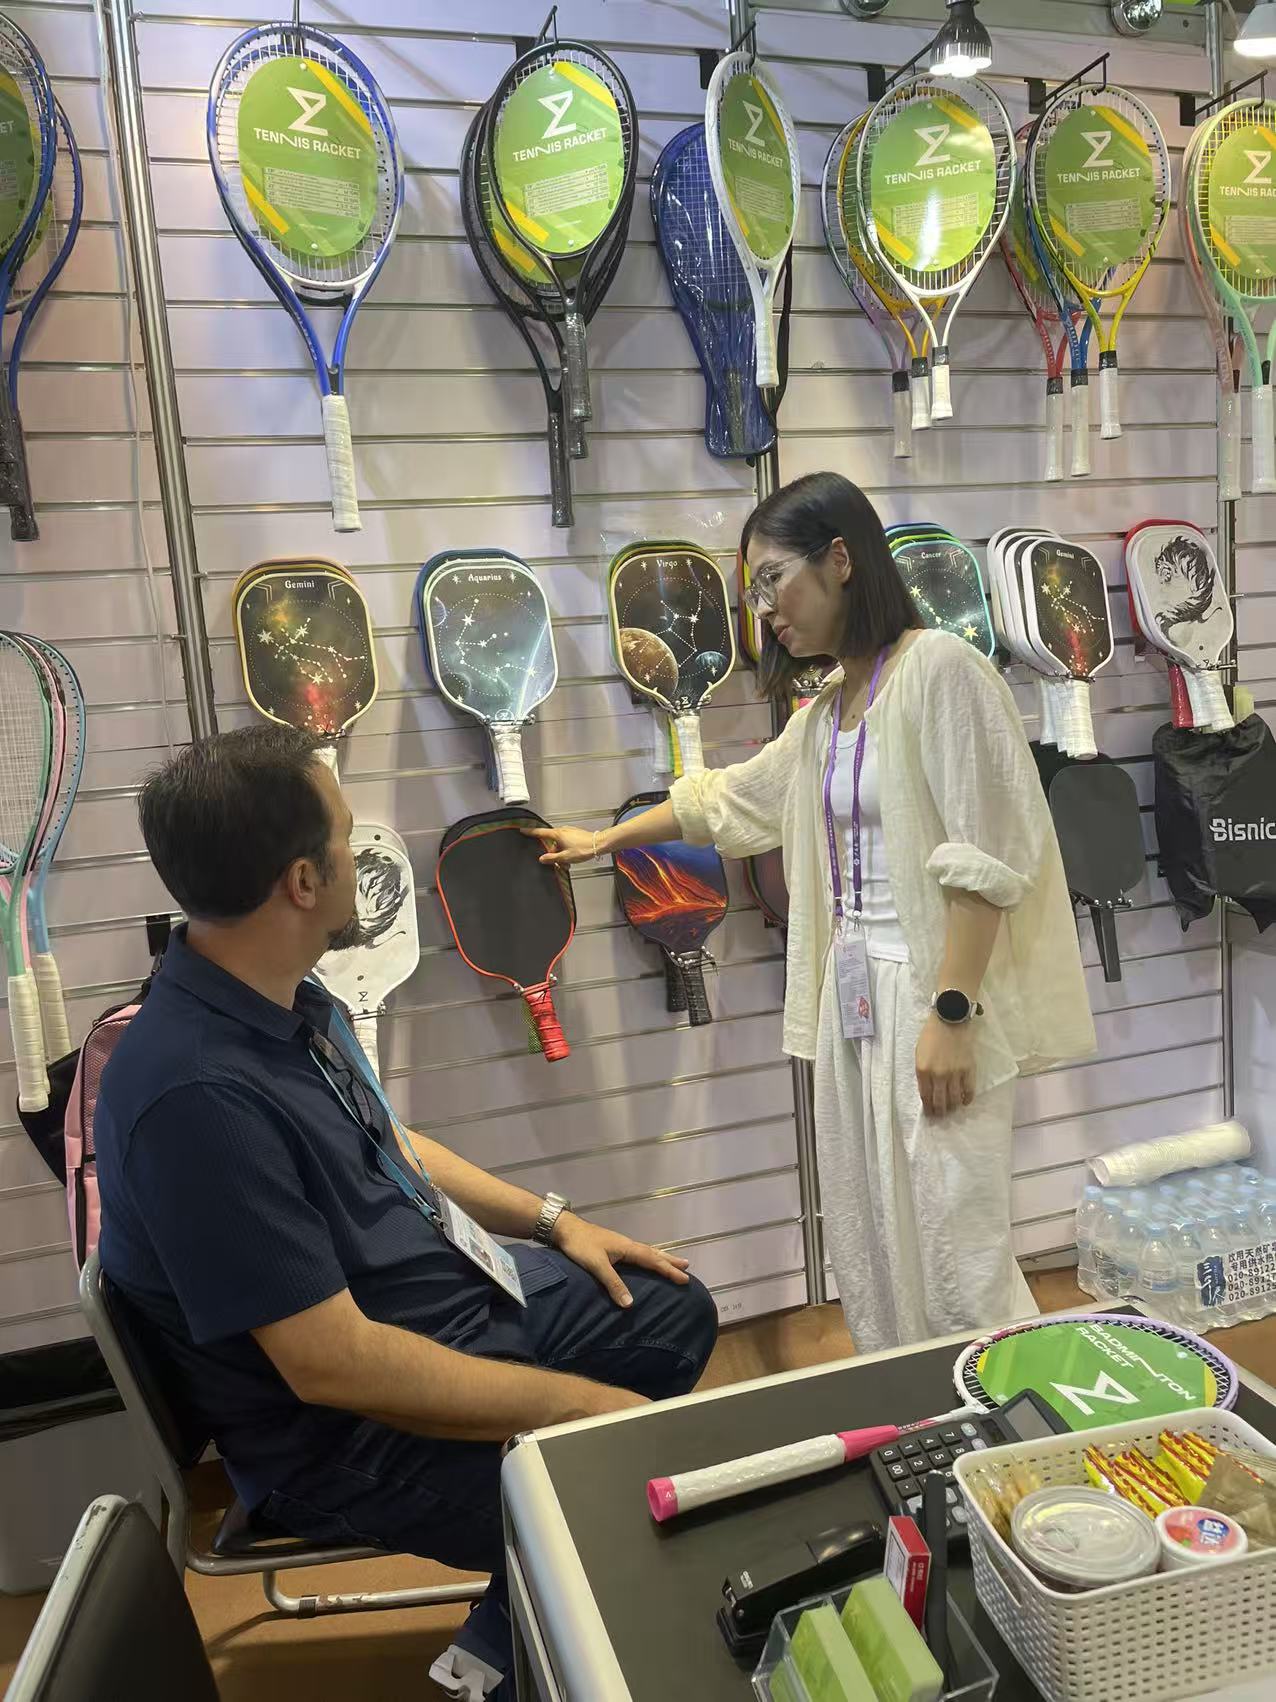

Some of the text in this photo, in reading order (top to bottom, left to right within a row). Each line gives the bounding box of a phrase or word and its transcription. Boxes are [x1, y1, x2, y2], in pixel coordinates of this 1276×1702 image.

[253, 127, 361, 160] TENNIS RACKET
[512, 127, 608, 162] TENNIS RACKET
[727, 137, 784, 169] TENNIS RACKET
[884, 160, 982, 185] TENNIS RACKET
[1057, 168, 1141, 183] TENNIS RACKET
[1219, 186, 1258, 197] TENNIS
[656, 559, 678, 570] Virgo
[921, 551, 942, 560] Cancer
[1056, 549, 1075, 560] Gemini
[284, 579, 315, 589] Gemini
[468, 573, 502, 584] Aquarius
[1209, 816, 1276, 842] Bisnic
[1075, 1326, 1135, 1369] RACKET
[1088, 1323, 1197, 1401] BADMINTON
[884, 1449, 903, 1475] 0 00
